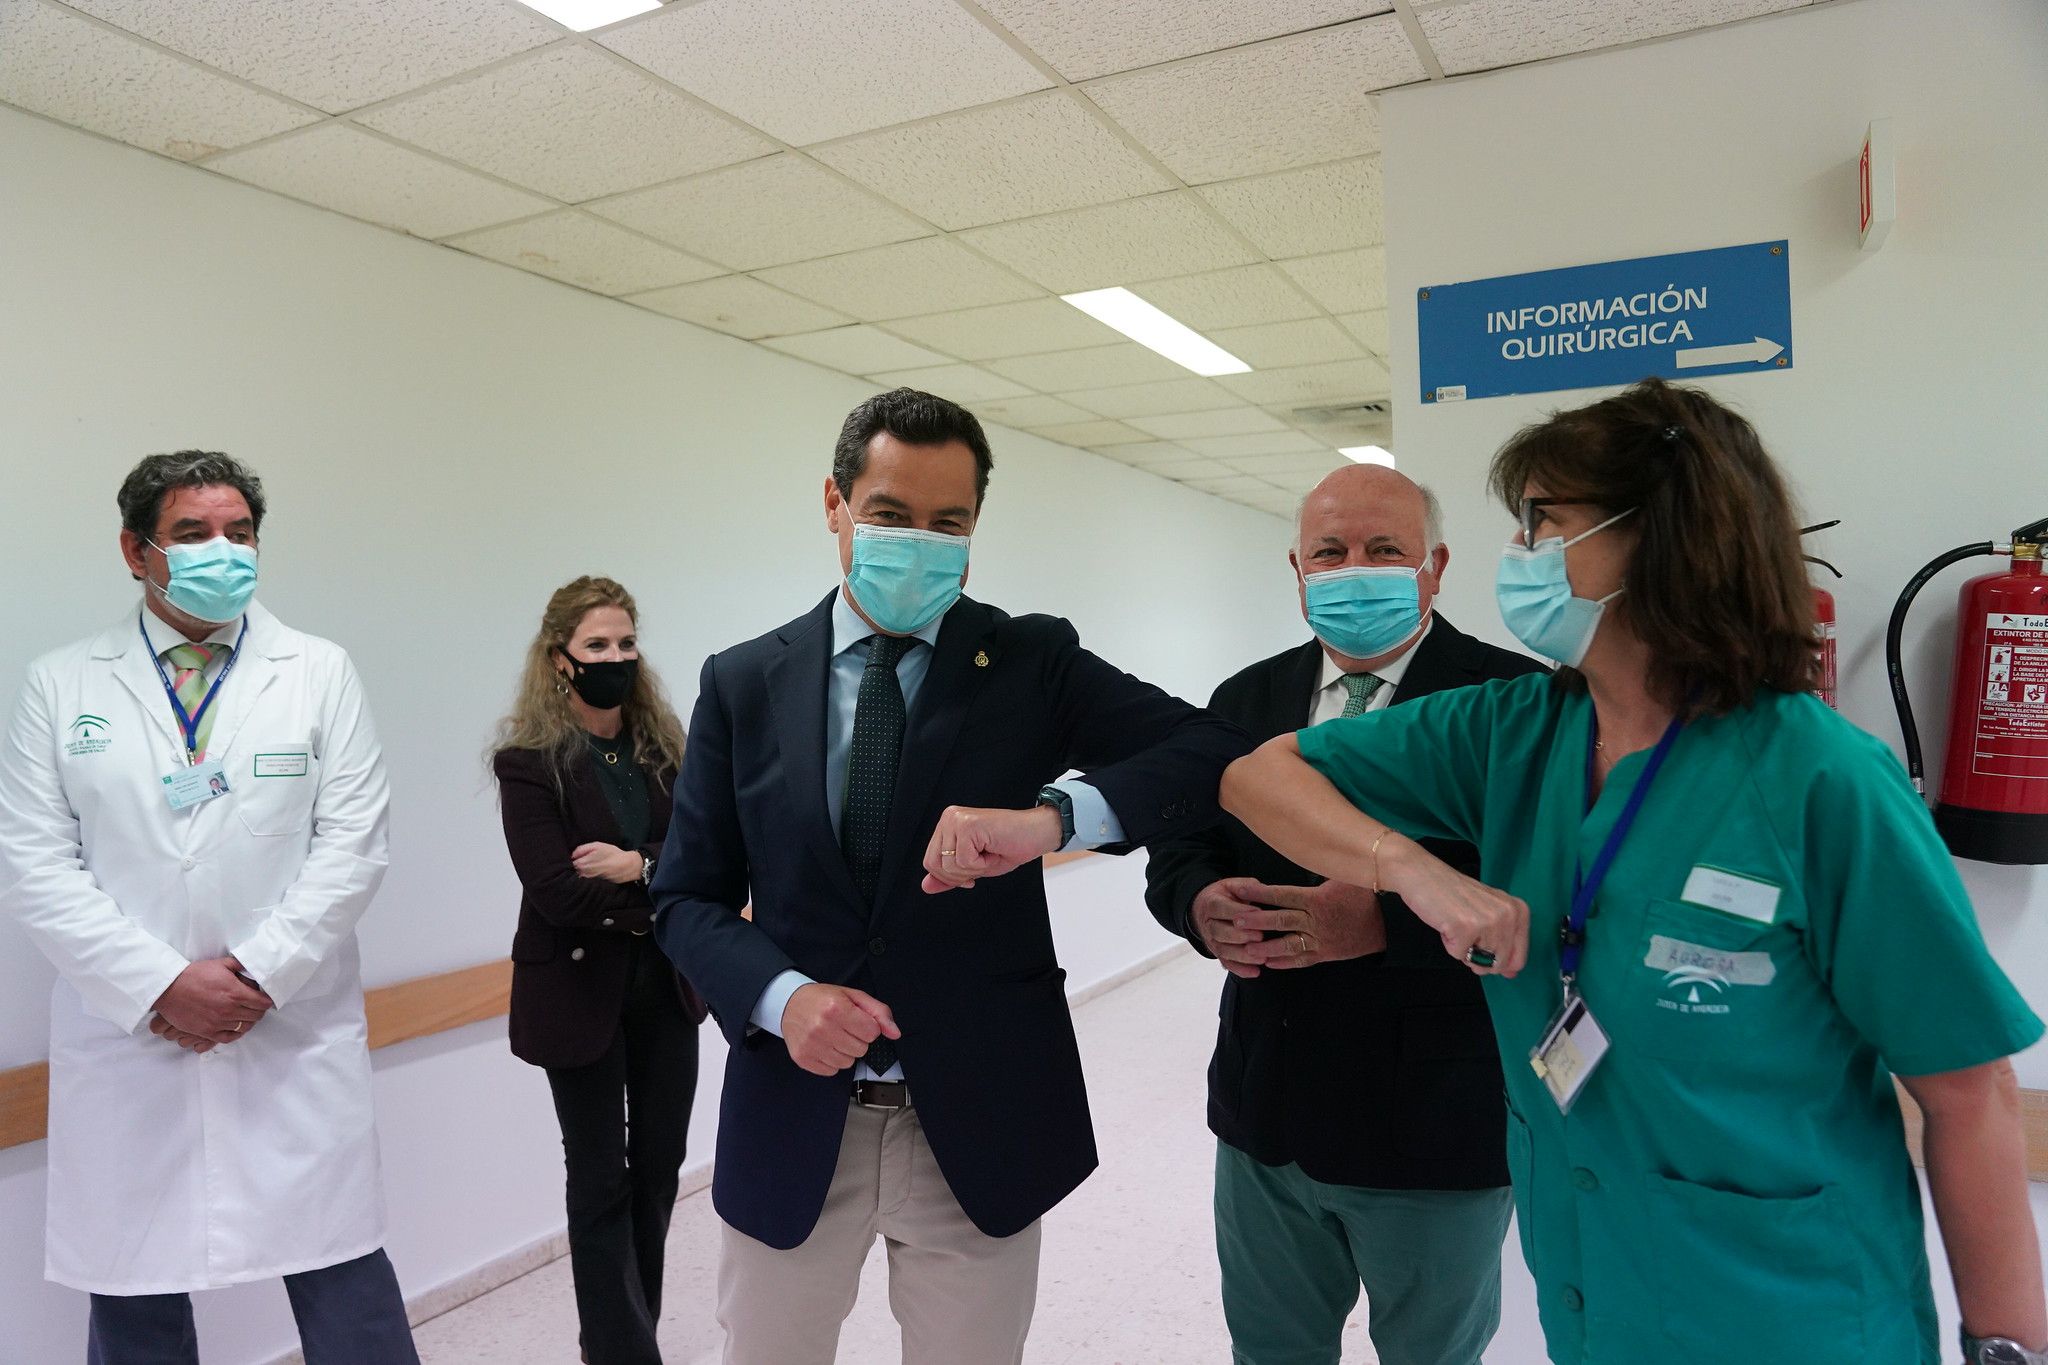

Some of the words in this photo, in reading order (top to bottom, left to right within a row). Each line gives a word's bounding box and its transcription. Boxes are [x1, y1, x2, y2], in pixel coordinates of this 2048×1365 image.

[1487, 283, 1708, 333] INFORMACIÓN
[1501, 319, 1693, 361] QUIRÚRGICA
[1994, 630, 2031, 638] EXTINTOR
[2033, 631, 2044, 639] DE
